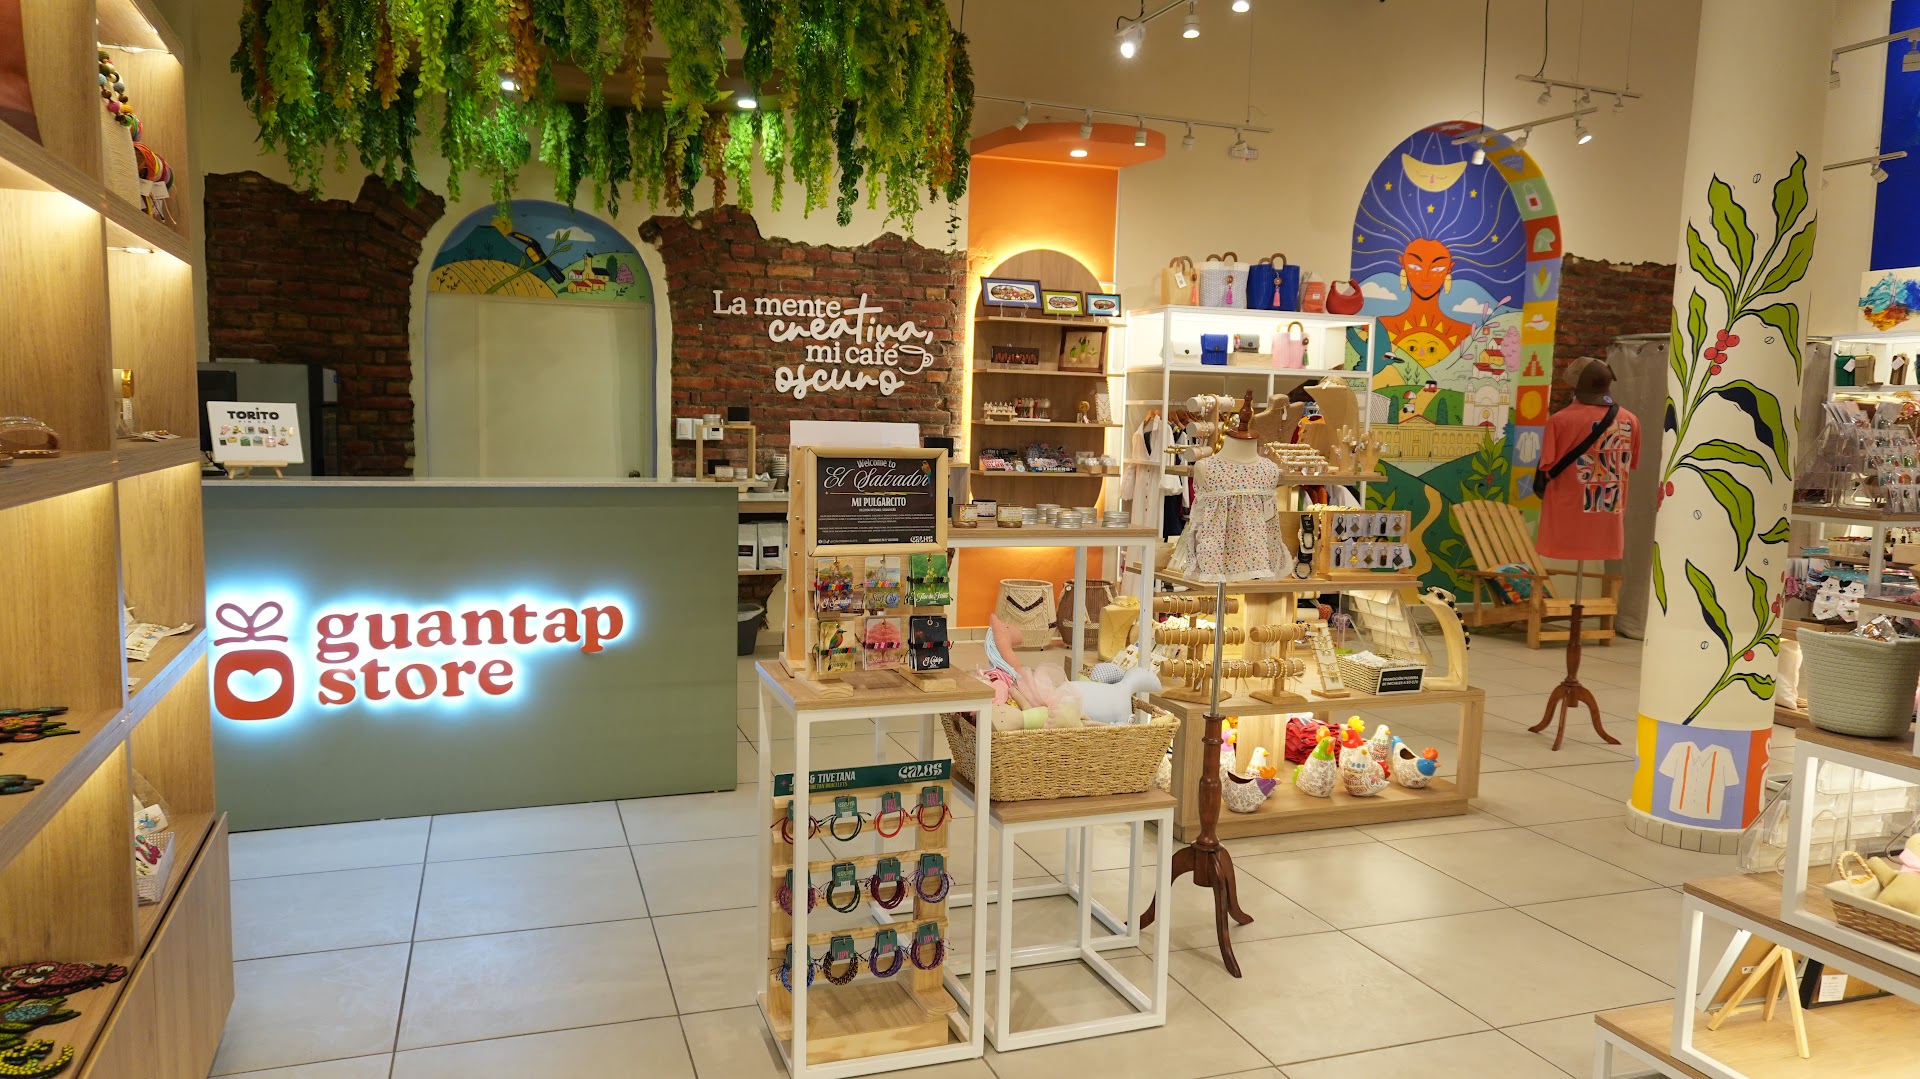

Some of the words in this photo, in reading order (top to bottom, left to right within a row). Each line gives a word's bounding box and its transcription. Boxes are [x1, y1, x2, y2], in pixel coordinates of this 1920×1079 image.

[712, 289, 748, 315] La
[753, 297, 841, 318] mente
[768, 292, 934, 345] creativa,
[805, 341, 842, 363] mi
[845, 342, 899, 366] café
[774, 364, 905, 400] oscuro
[226, 408, 280, 420] TORITO
[857, 459, 887, 469] Welcome
[888, 460, 897, 469] to
[823, 466, 856, 489] El
[853, 467, 929, 492] Salvador
[851, 497, 862, 507] MI
[863, 496, 907, 507] PULGARCITO
[316, 603, 624, 664] guantap
[318, 658, 514, 706] store
[817, 771, 856, 784] TIVETANA
